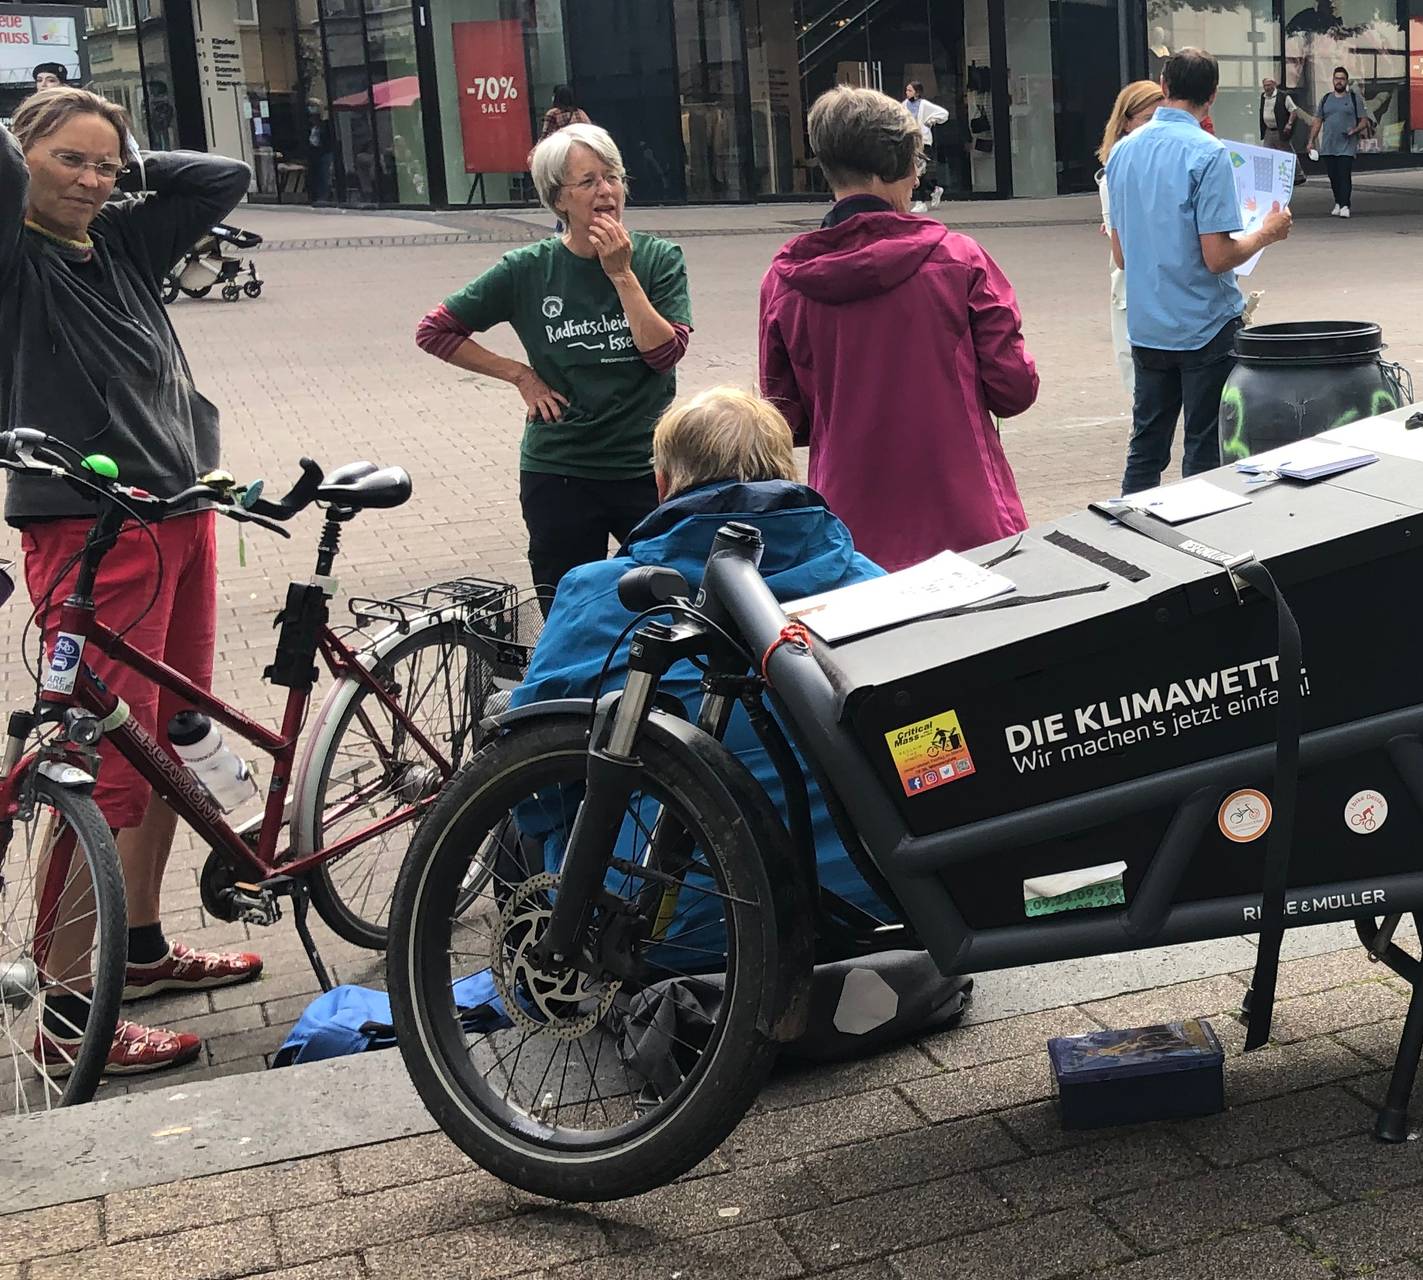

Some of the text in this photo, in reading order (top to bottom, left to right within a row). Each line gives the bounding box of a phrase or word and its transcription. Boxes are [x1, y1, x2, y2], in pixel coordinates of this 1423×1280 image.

[466, 76, 518, 101] -70%
[481, 102, 507, 114] SALE
[894, 733, 920, 748] Mass
[897, 721, 933, 740] Critical
[1005, 713, 1068, 753] DIE
[1012, 750, 1053, 774] Wir
[1172, 702, 1222, 737] jetzt
[1313, 889, 1386, 911] MÜLLER
